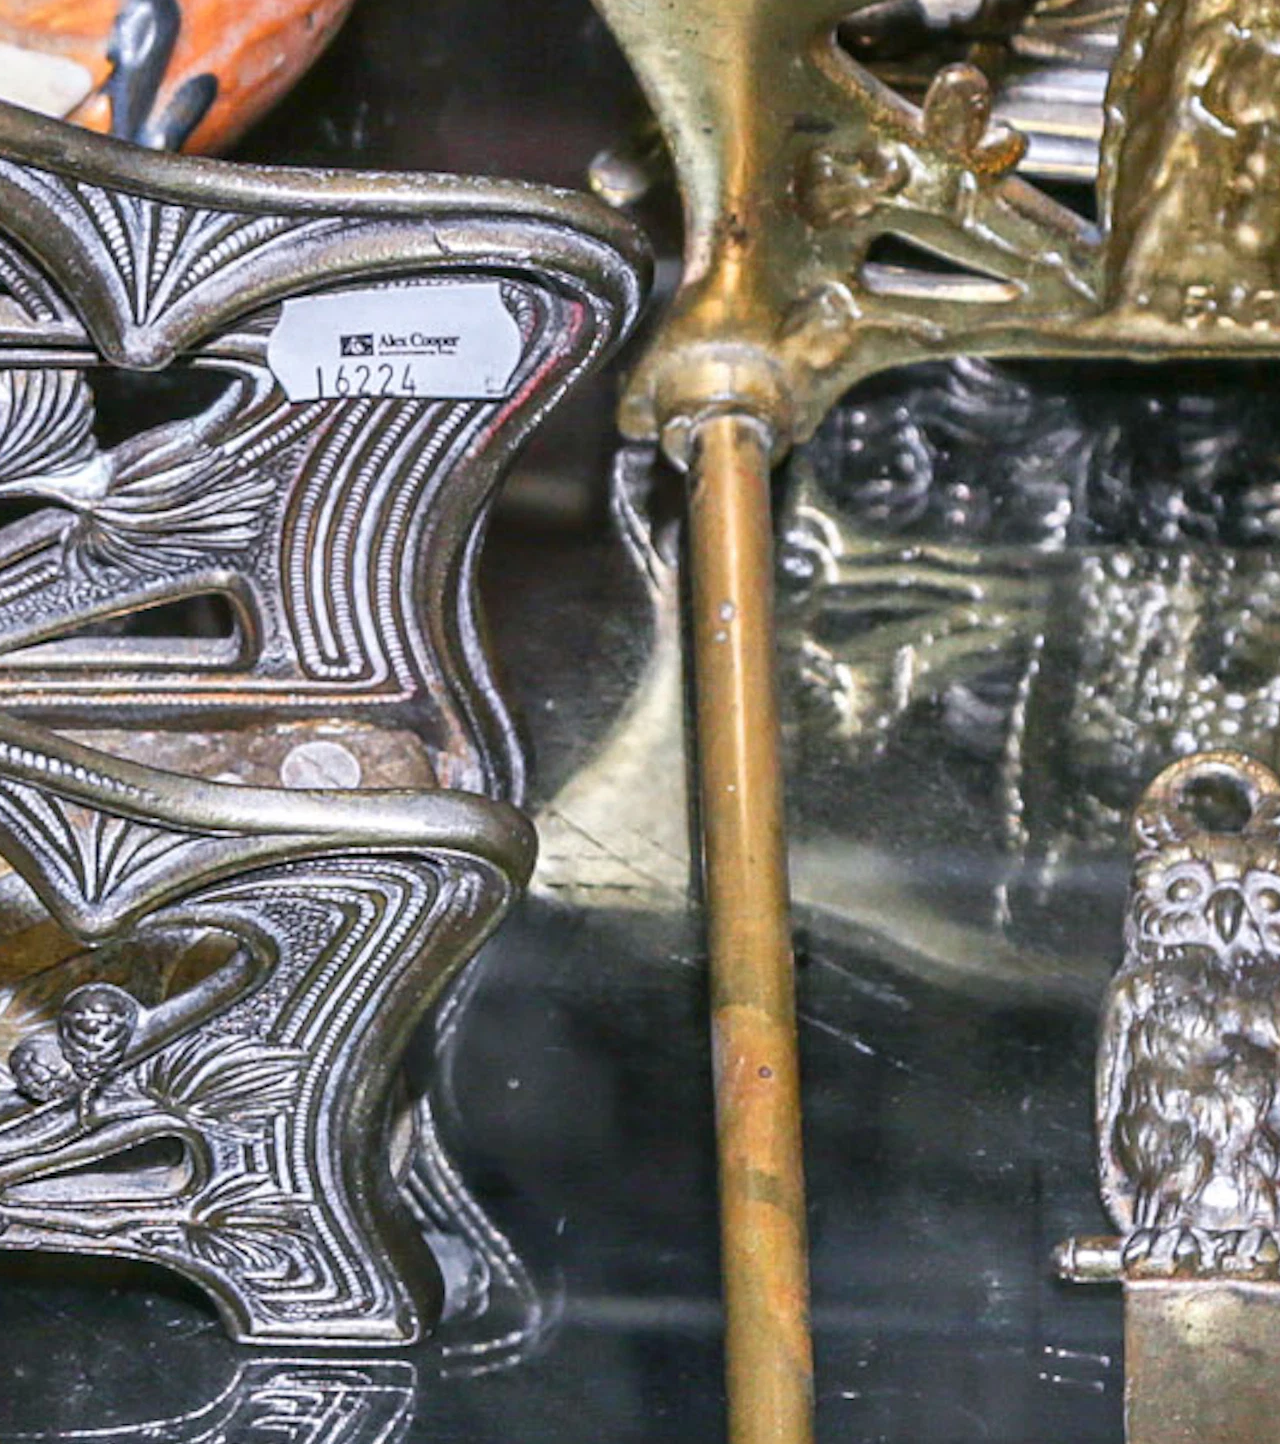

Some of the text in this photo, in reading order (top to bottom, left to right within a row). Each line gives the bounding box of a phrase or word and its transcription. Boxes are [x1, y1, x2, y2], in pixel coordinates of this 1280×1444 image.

[378, 332, 460, 354] Alex Cooper
[317, 362, 417, 397] 16224
